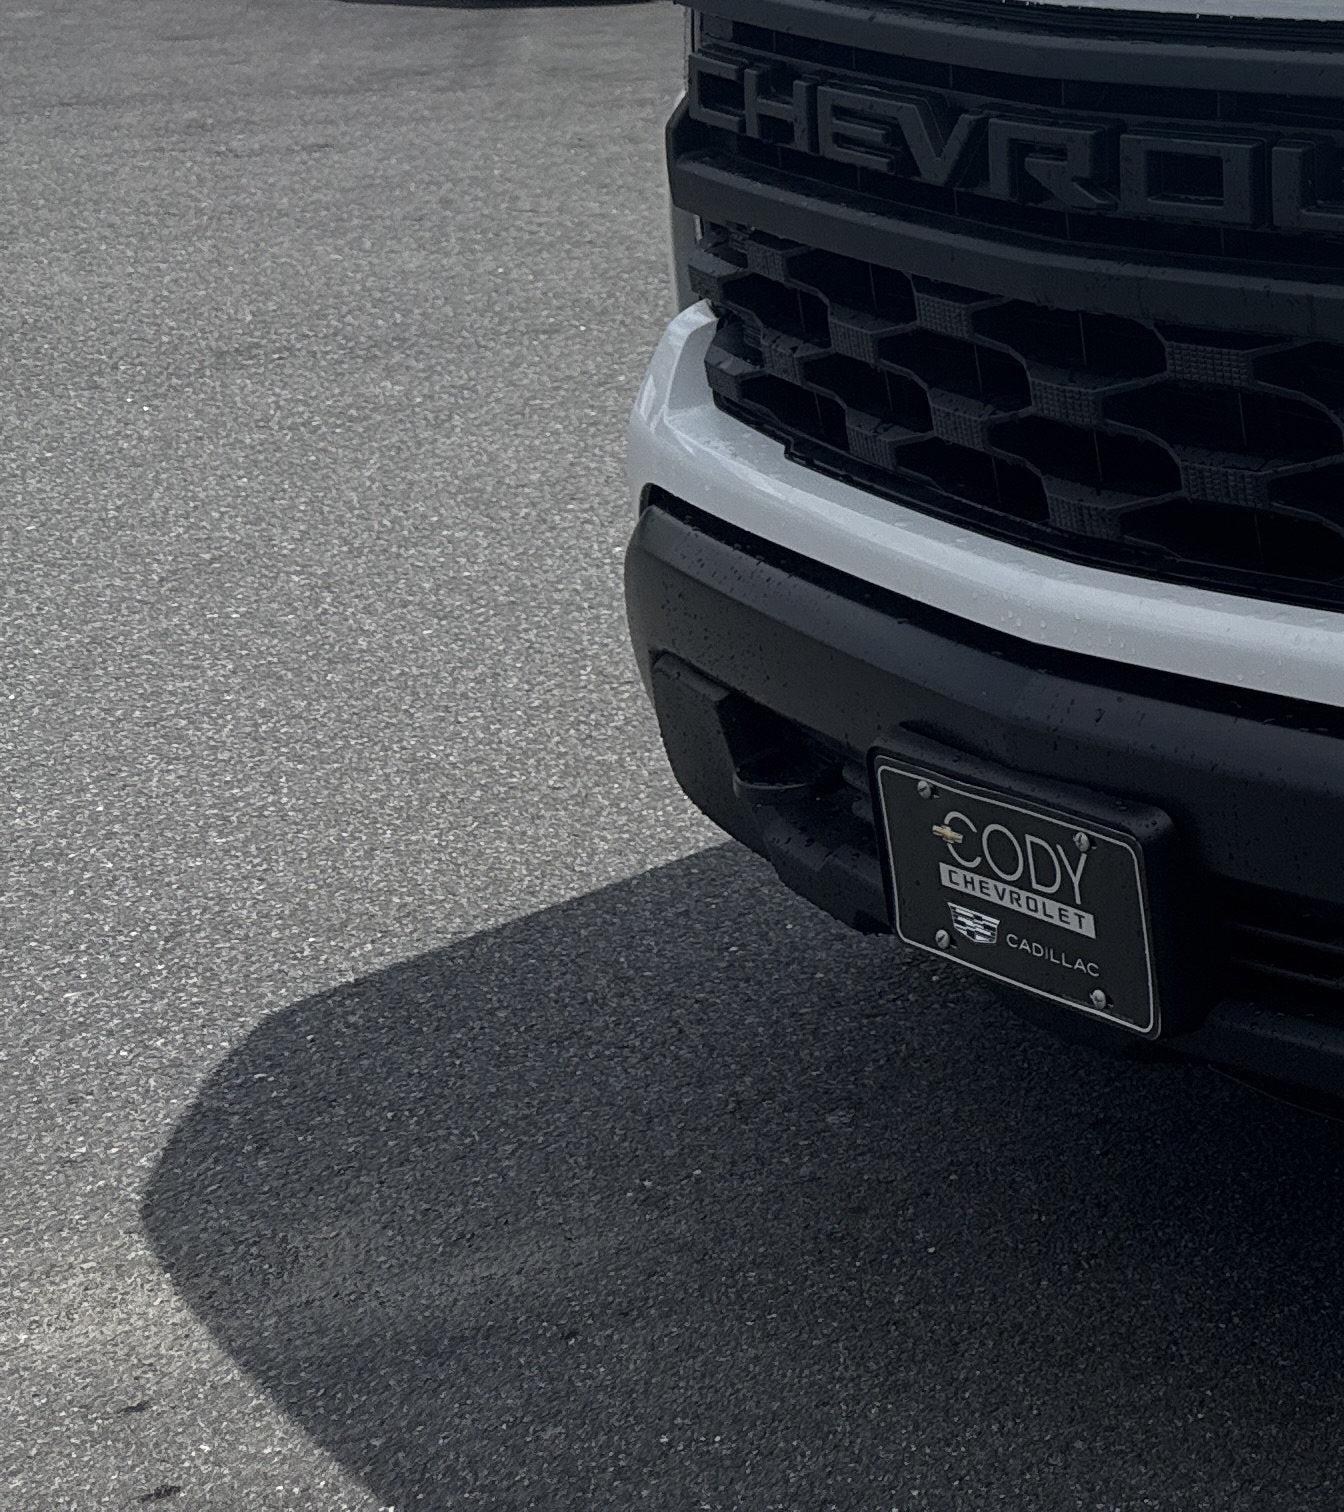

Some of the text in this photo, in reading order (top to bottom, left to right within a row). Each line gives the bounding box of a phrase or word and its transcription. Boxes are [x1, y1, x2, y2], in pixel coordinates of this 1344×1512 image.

[943, 810, 1088, 905] CODY
[948, 868, 1087, 931] CHEVROLET
[1005, 933, 1100, 978] CADILLAC
